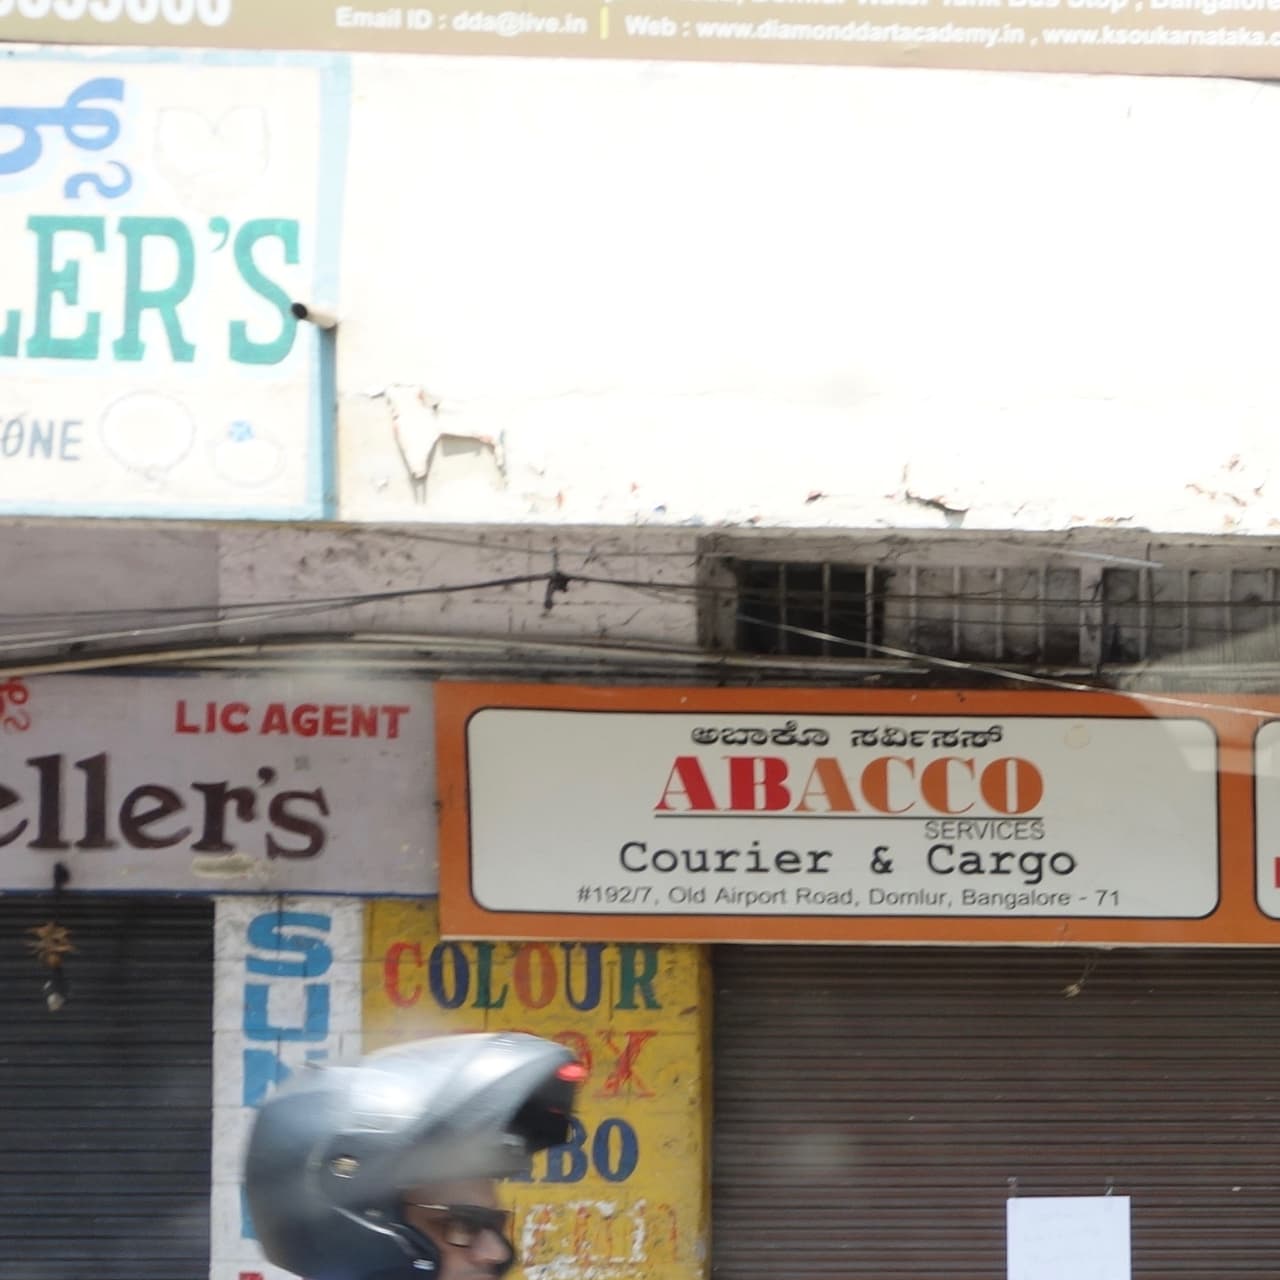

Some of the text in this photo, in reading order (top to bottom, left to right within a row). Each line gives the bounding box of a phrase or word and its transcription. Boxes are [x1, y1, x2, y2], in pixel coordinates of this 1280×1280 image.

[335, 7, 402, 28] Email
[407, 9, 433, 29] ID
[451, 11, 588, 37] dda@live.in
[624, 15, 678, 37] Web
[0, 216, 300, 365] ER'S
[0, 413, 83, 462] ONE
[175, 701, 410, 739] LIC AGENT
[654, 755, 1044, 815] ABACCO
[923, 820, 1046, 841] SERVICES
[619, 840, 1078, 885] Courier & Cargo
[576, 885, 660, 906] #192/7,
[668, 886, 706, 904] Old
[715, 886, 786, 908] Airport
[796, 887, 860, 909] Road,
[868, 888, 953, 908] Domlur,
[961, 889, 1071, 911] Bangalore
[1094, 889, 1120, 907] 71
[383, 942, 663, 1011] COLOUR
